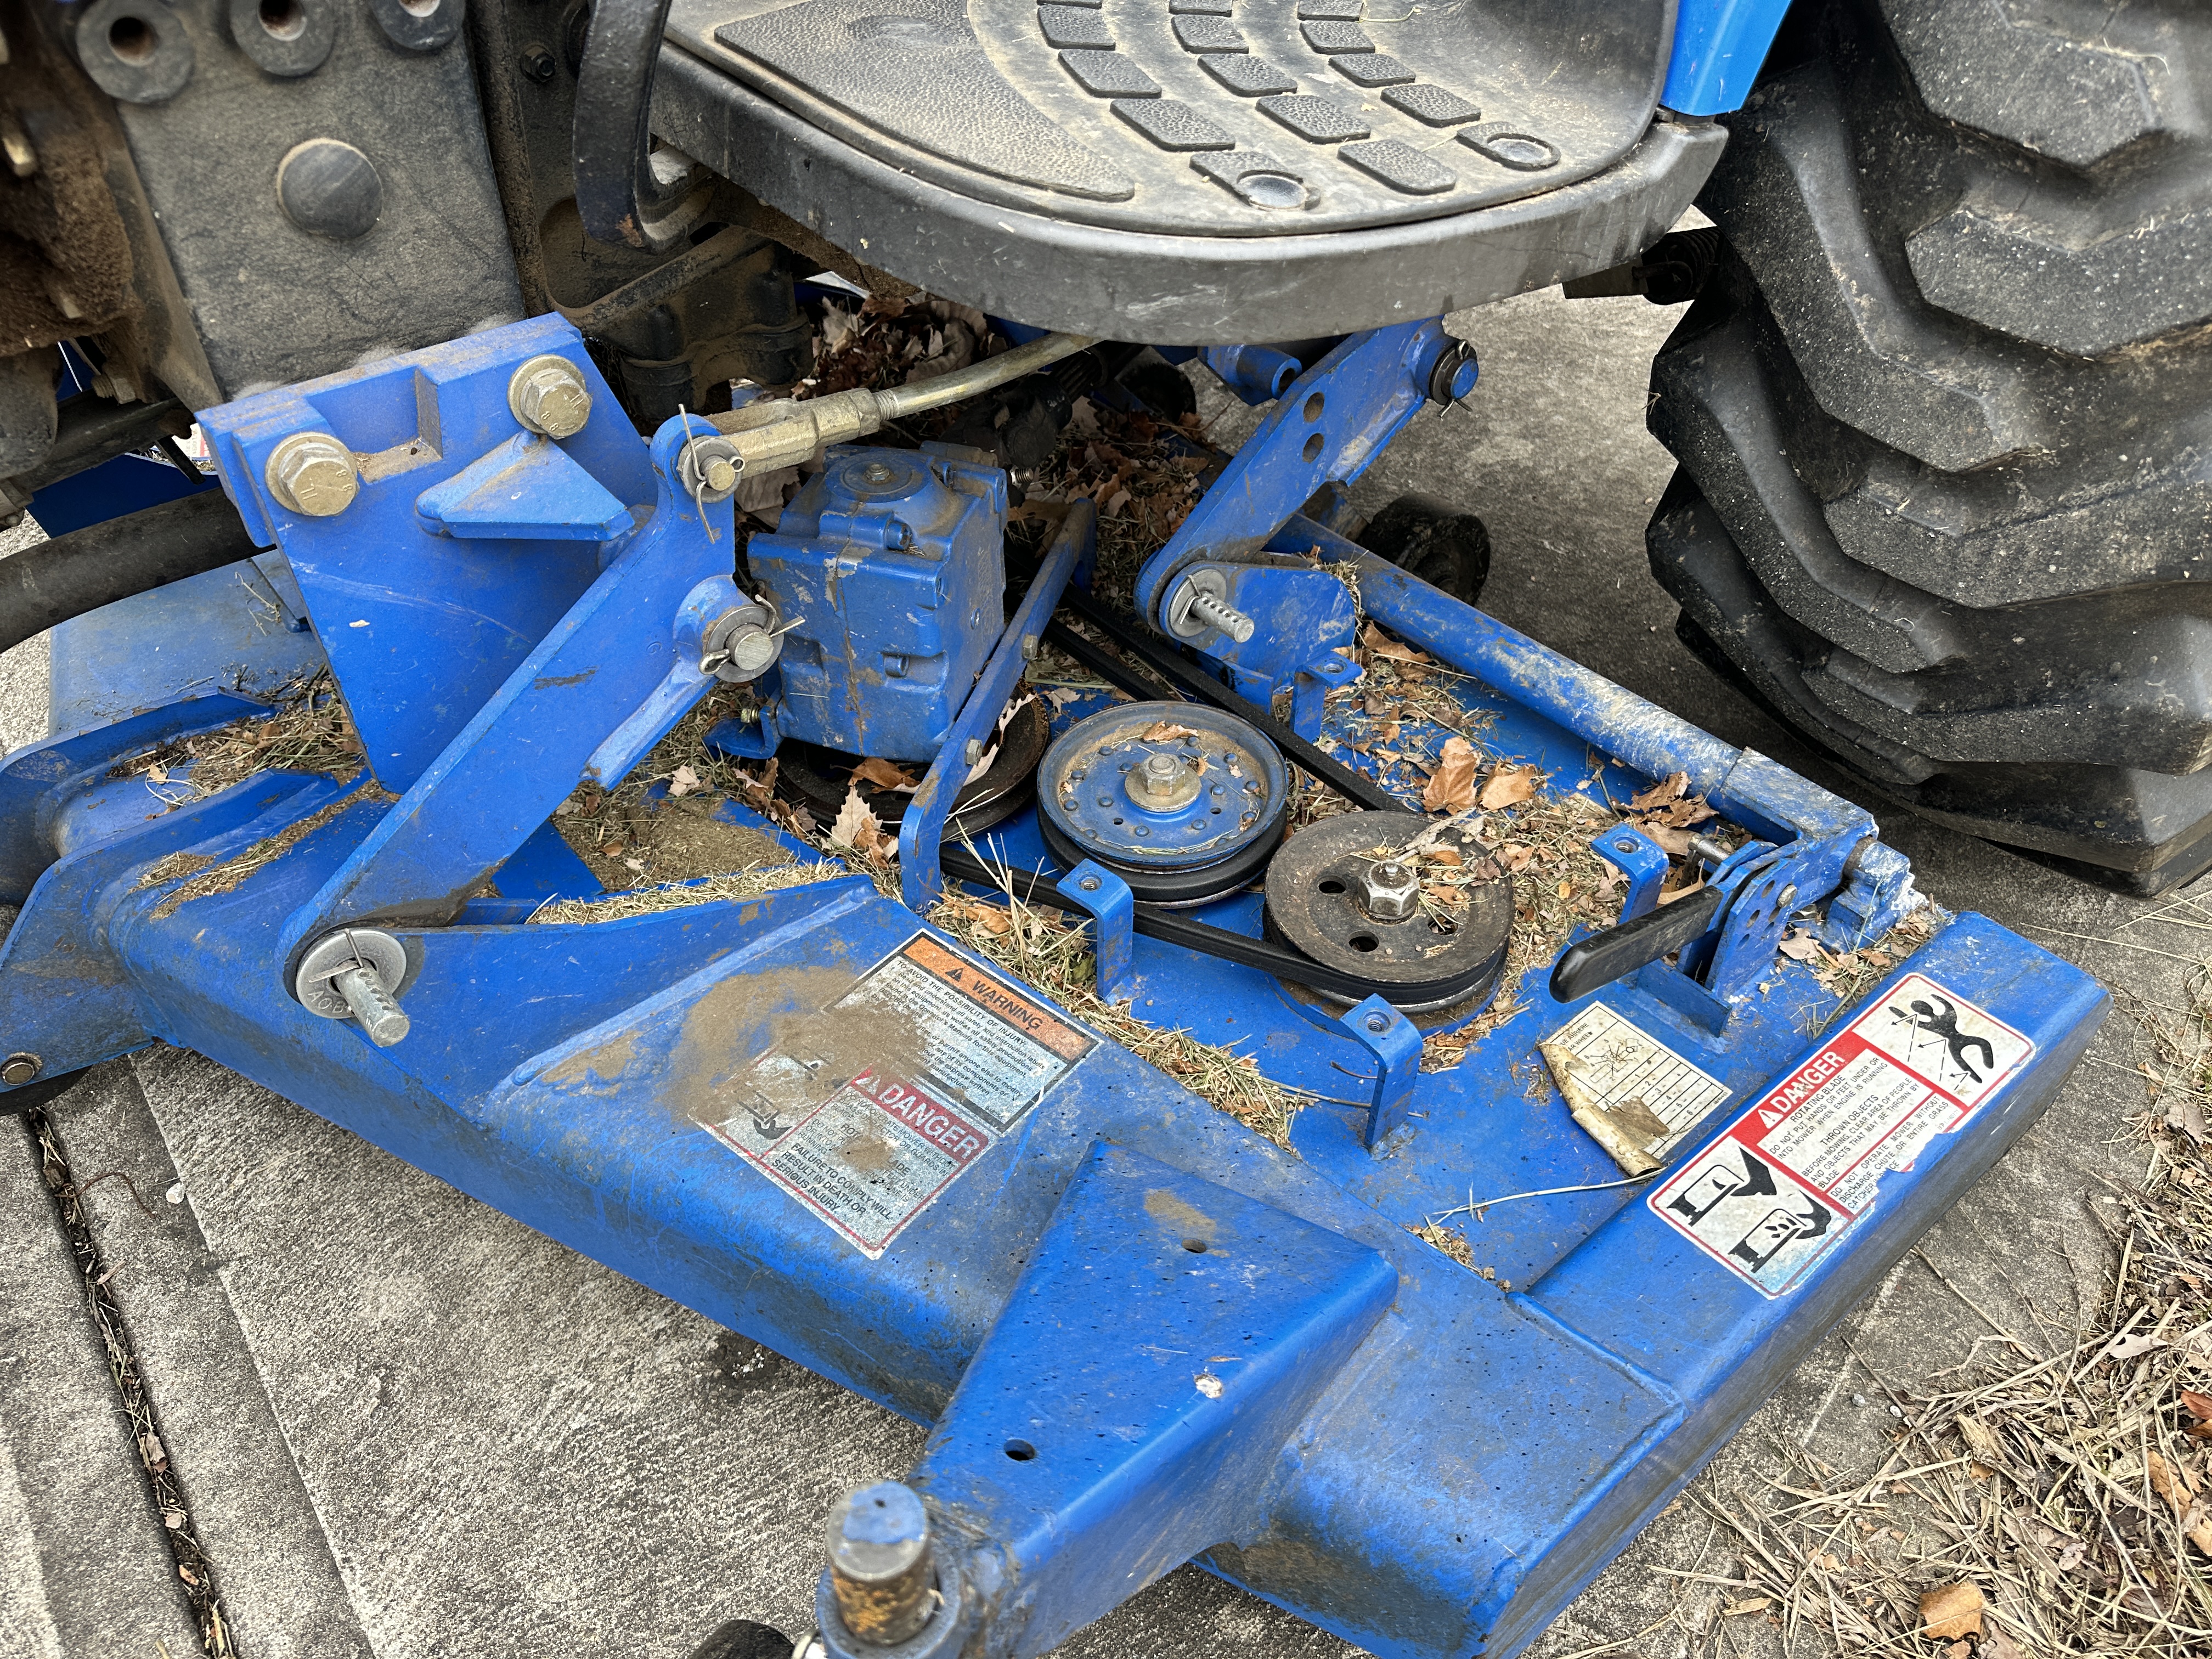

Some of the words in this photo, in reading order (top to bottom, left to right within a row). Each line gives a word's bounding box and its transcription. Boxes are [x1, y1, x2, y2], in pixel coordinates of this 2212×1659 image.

[896, 961, 907, 969] TO
[907, 968, 928, 983] AVOID
[928, 981, 943, 992] THE
[944, 992, 986, 1020] POSSIBILITY
[986, 1019, 998, 1028] OF
[970, 981, 1043, 1029] WARNING
[982, 1027, 995, 1036] and
[997, 1047, 1033, 1071] precautions
[962, 1065, 1000, 1092] components
[1769, 1144, 1781, 1154] DO
[1780, 1132, 1795, 1144] NOT
[1793, 1121, 1807, 1132] PUT
[1805, 1103, 1827, 1121] HANDS
[1825, 1095, 1837, 1104] OR
[1835, 1082, 1851, 1094] FEET
[1850, 1065, 1870, 1082] UNDER
[1869, 1057, 1880, 1065] OR
[1771, 1051, 1844, 1111] DANGER
[1790, 1093, 1824, 1122] ROTATING
[1821, 1075, 1845, 1094] BLADE
[879, 1083, 979, 1159] DANGER
[898, 1128, 924, 1148] MOWER
[1778, 1146, 1793, 1159] INTO
[1793, 1125, 1816, 1146] MOWER
[1816, 1109, 1834, 1125] WHEN
[1833, 1090, 1855, 1109] ENGINE
[1862, 1062, 1887, 1084] RUNNING
[1802, 1155, 1827, 1177] BEFORE
[1825, 1132, 1852, 1156] MOWING,
[1848, 1116, 1869, 1133] CLEAR
[1866, 1103, 1883, 1117] AREA
[1881, 1096, 1892, 1104] OF
[1889, 1077, 1911, 1097] PEOPLE
[1810, 1170, 1825, 1182] AND
[1824, 1146, 1850, 1170] OBJECTS
[1849, 1132, 1866, 1146] THAT
[1864, 1120, 1878, 1132] MAY
[1877, 1111, 1888, 1120] BE
[1886, 1090, 1911, 1111] THROWN
[1909, 1082, 1919, 1091] BY
[1820, 1120, 1850, 1146] THROWN
[1848, 1094, 1878, 1121] OBJECTS
[772, 1159, 810, 1189] SERIOUS
[899, 1140, 911, 1150] OR
[910, 1148, 939, 1171] GUARDS
[1831, 1187, 1843, 1197] DO
[1844, 1171, 1859, 1184] NOT
[1860, 1144, 1889, 1169] OPERATE
[1890, 1121, 1913, 1141] MOWER
[1914, 1096, 1940, 1119] WITHOUT
[1839, 1171, 1874, 1203] DISCHARGE
[1874, 1151, 1895, 1170] CHUTE
[1895, 1141, 1906, 1150] OR
[1906, 1120, 1928, 1139] ENTIRE
[1927, 1101, 1948, 1119] GRASS
[782, 1150, 816, 1177] RESULT
[813, 1174, 825, 1183] IN
[822, 1181, 852, 1205] DEATH
[850, 1202, 866, 1215] OR
[792, 1142, 827, 1170] FAILURE
[823, 1167, 839, 1179] TO
[837, 1176, 873, 1204] COMPLY
[870, 1200, 893, 1220] WILL
[1818, 1169, 1839, 1188] BLADE
[1847, 1183, 1875, 1209] CATCHER
